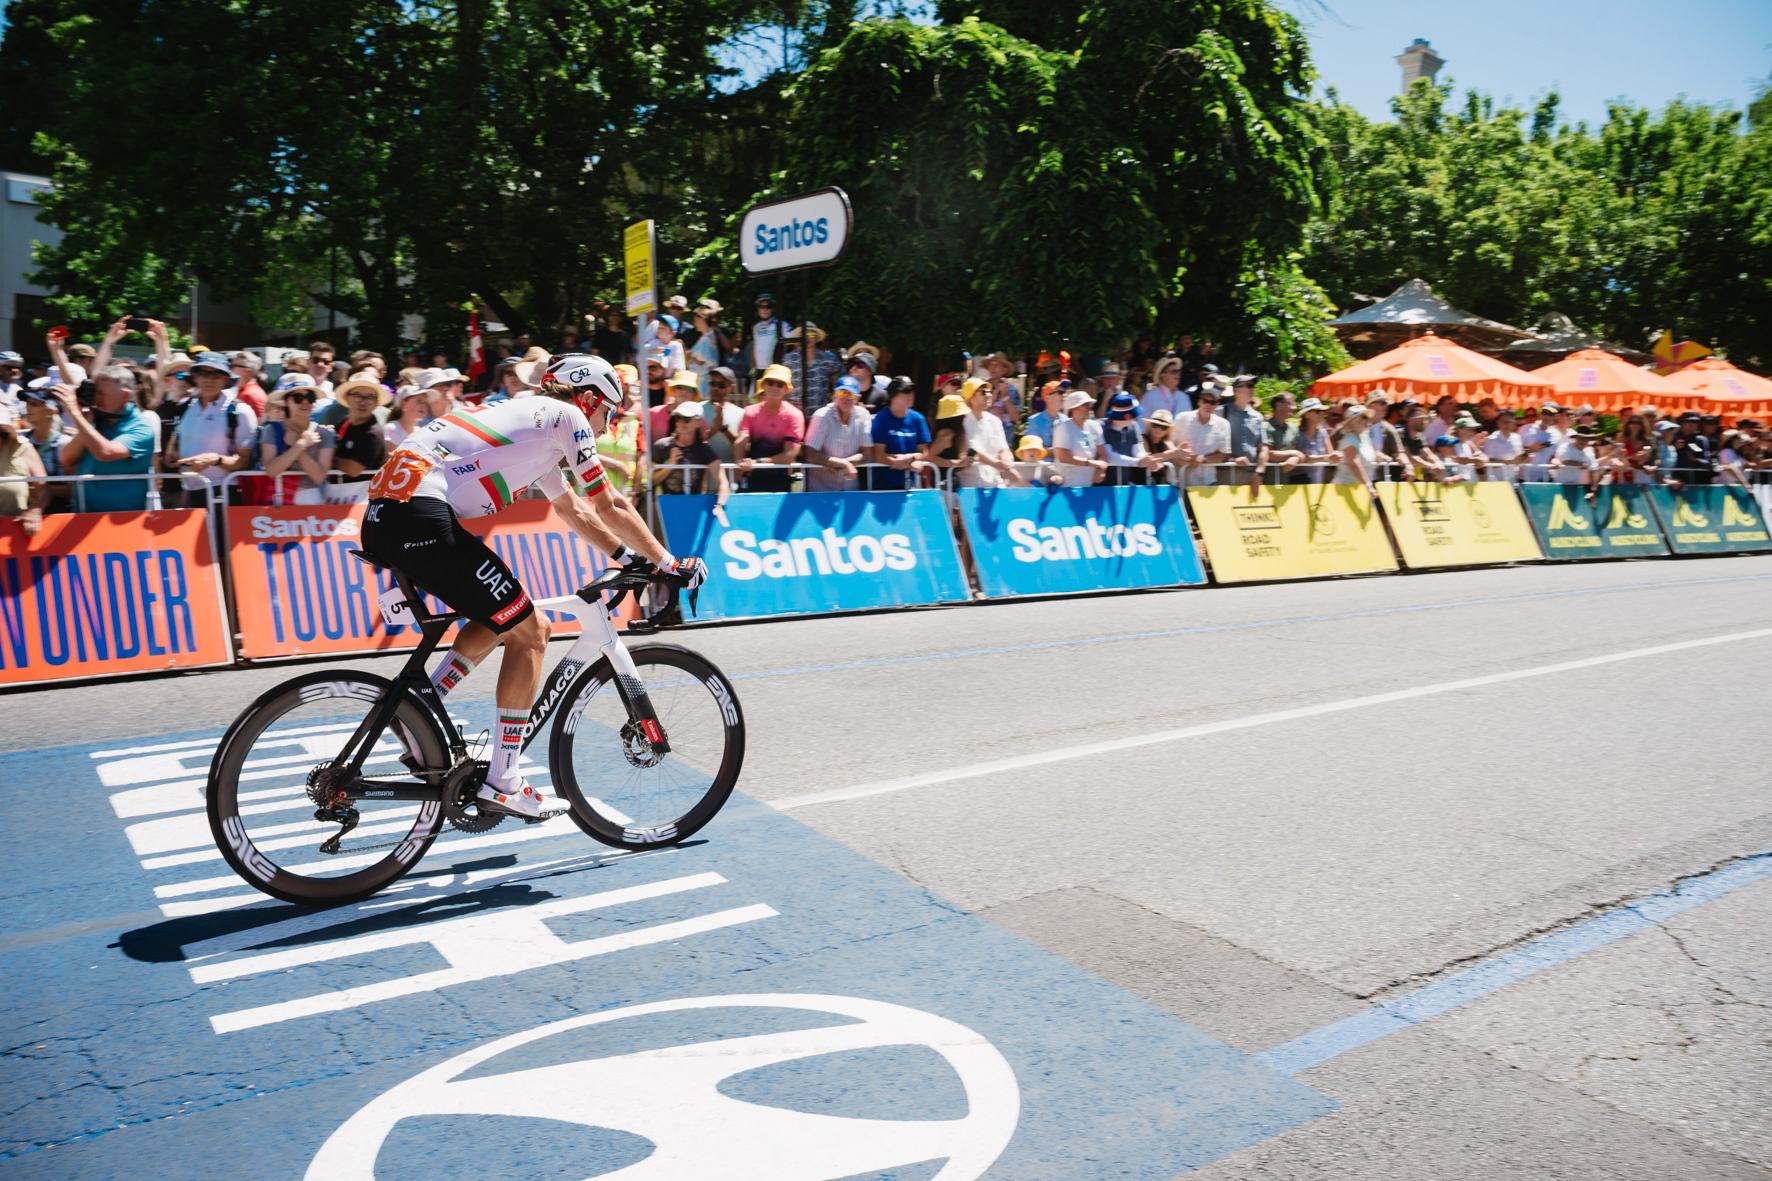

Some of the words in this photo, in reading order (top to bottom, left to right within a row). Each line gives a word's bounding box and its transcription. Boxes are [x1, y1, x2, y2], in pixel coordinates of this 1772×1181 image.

[755, 217, 828, 255] Santos
[569, 367, 592, 384] G42
[251, 515, 360, 539] Santos
[411, 538, 438, 548] PISSEI
[1007, 517, 1163, 563] Santos
[720, 527, 917, 581] Santos
[257, 540, 374, 643] TOUR
[475, 559, 513, 601] UAE
[30, 549, 198, 667] UNDER
[521, 664, 577, 745] OLNAGO
[503, 726, 524, 736] UAE
